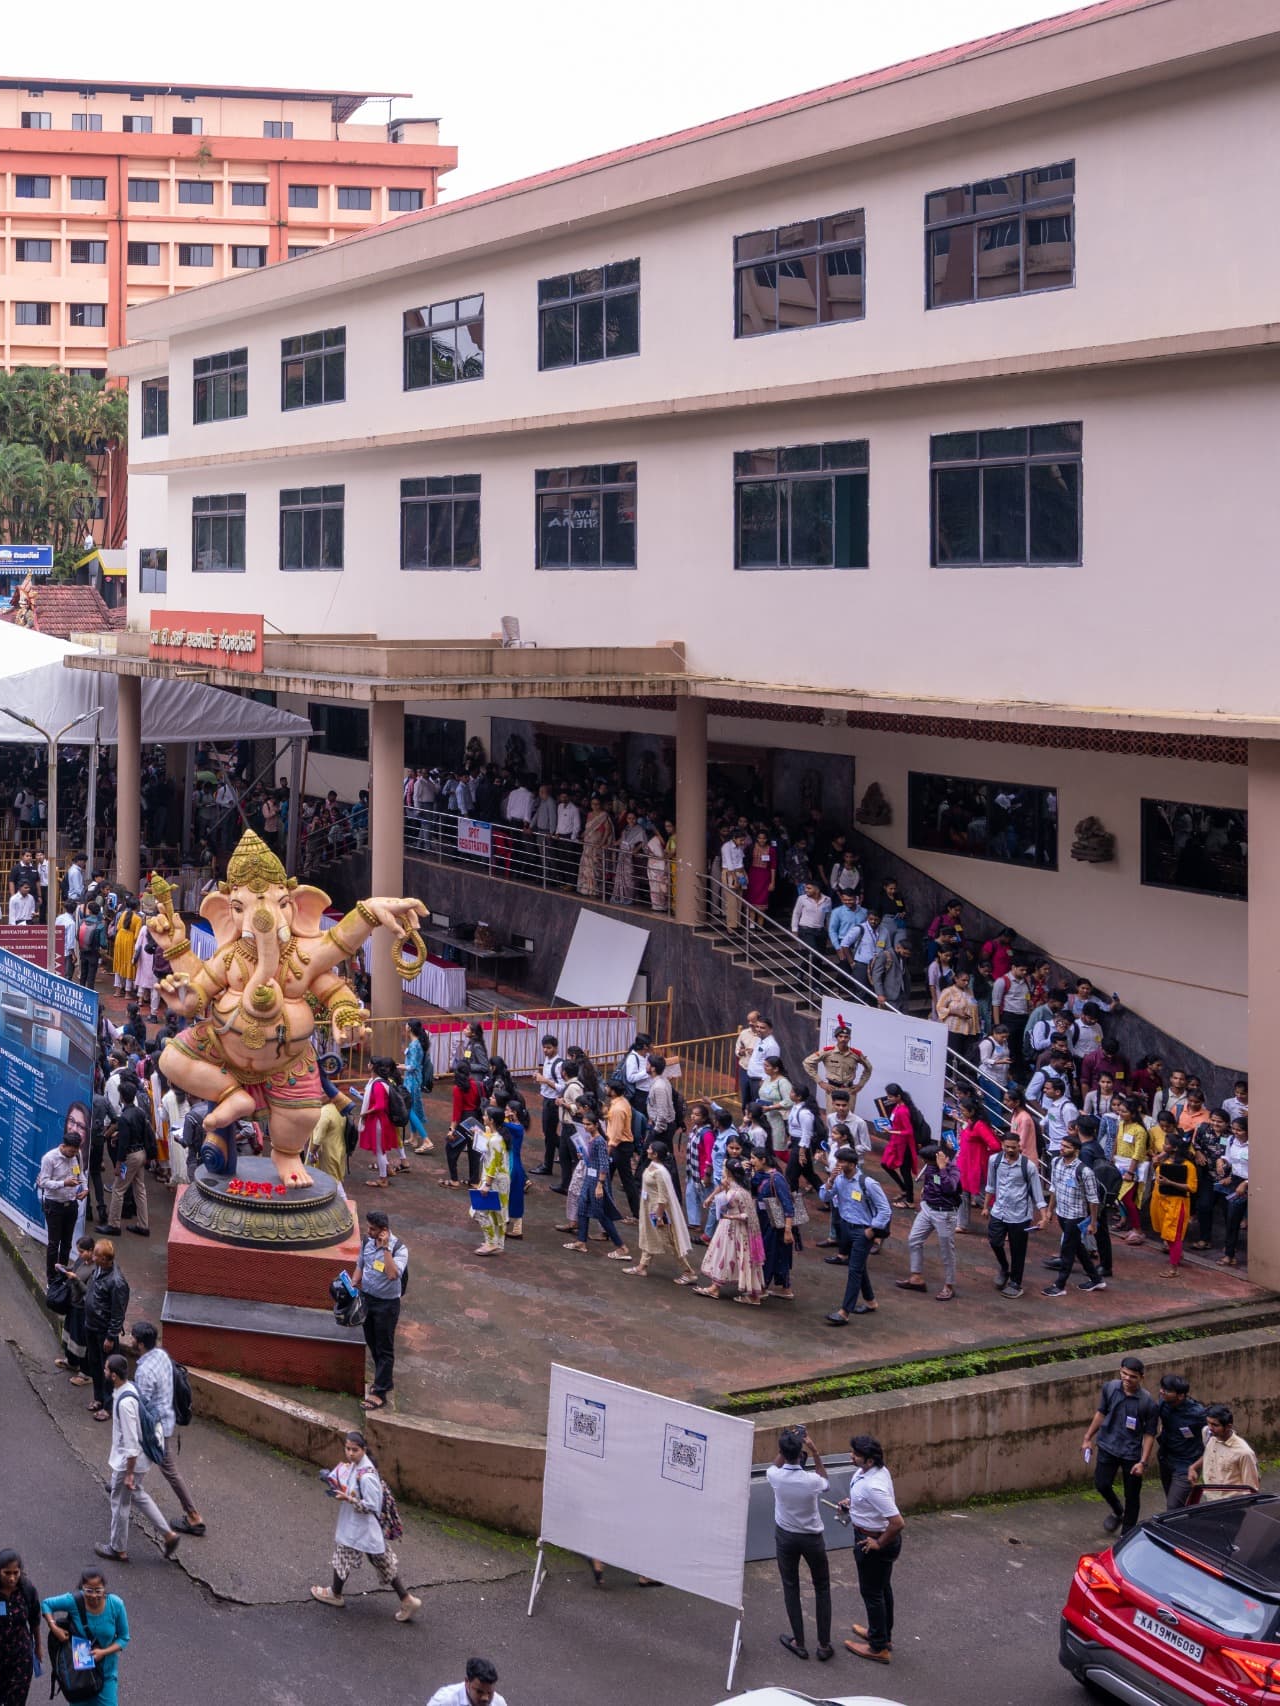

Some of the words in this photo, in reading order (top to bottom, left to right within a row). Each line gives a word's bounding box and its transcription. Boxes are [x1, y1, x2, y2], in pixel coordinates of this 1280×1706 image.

[468, 827, 480, 839] SPOT
[0, 964, 17, 981] SUPER
[17, 973, 53, 999] SPECIALITY
[54, 992, 93, 1016] HOSPITAL
[23, 965, 49, 987] HEALTH
[51, 979, 84, 1002] CENTRE
[1140, 1616, 1202, 1659] KA19MM6083
